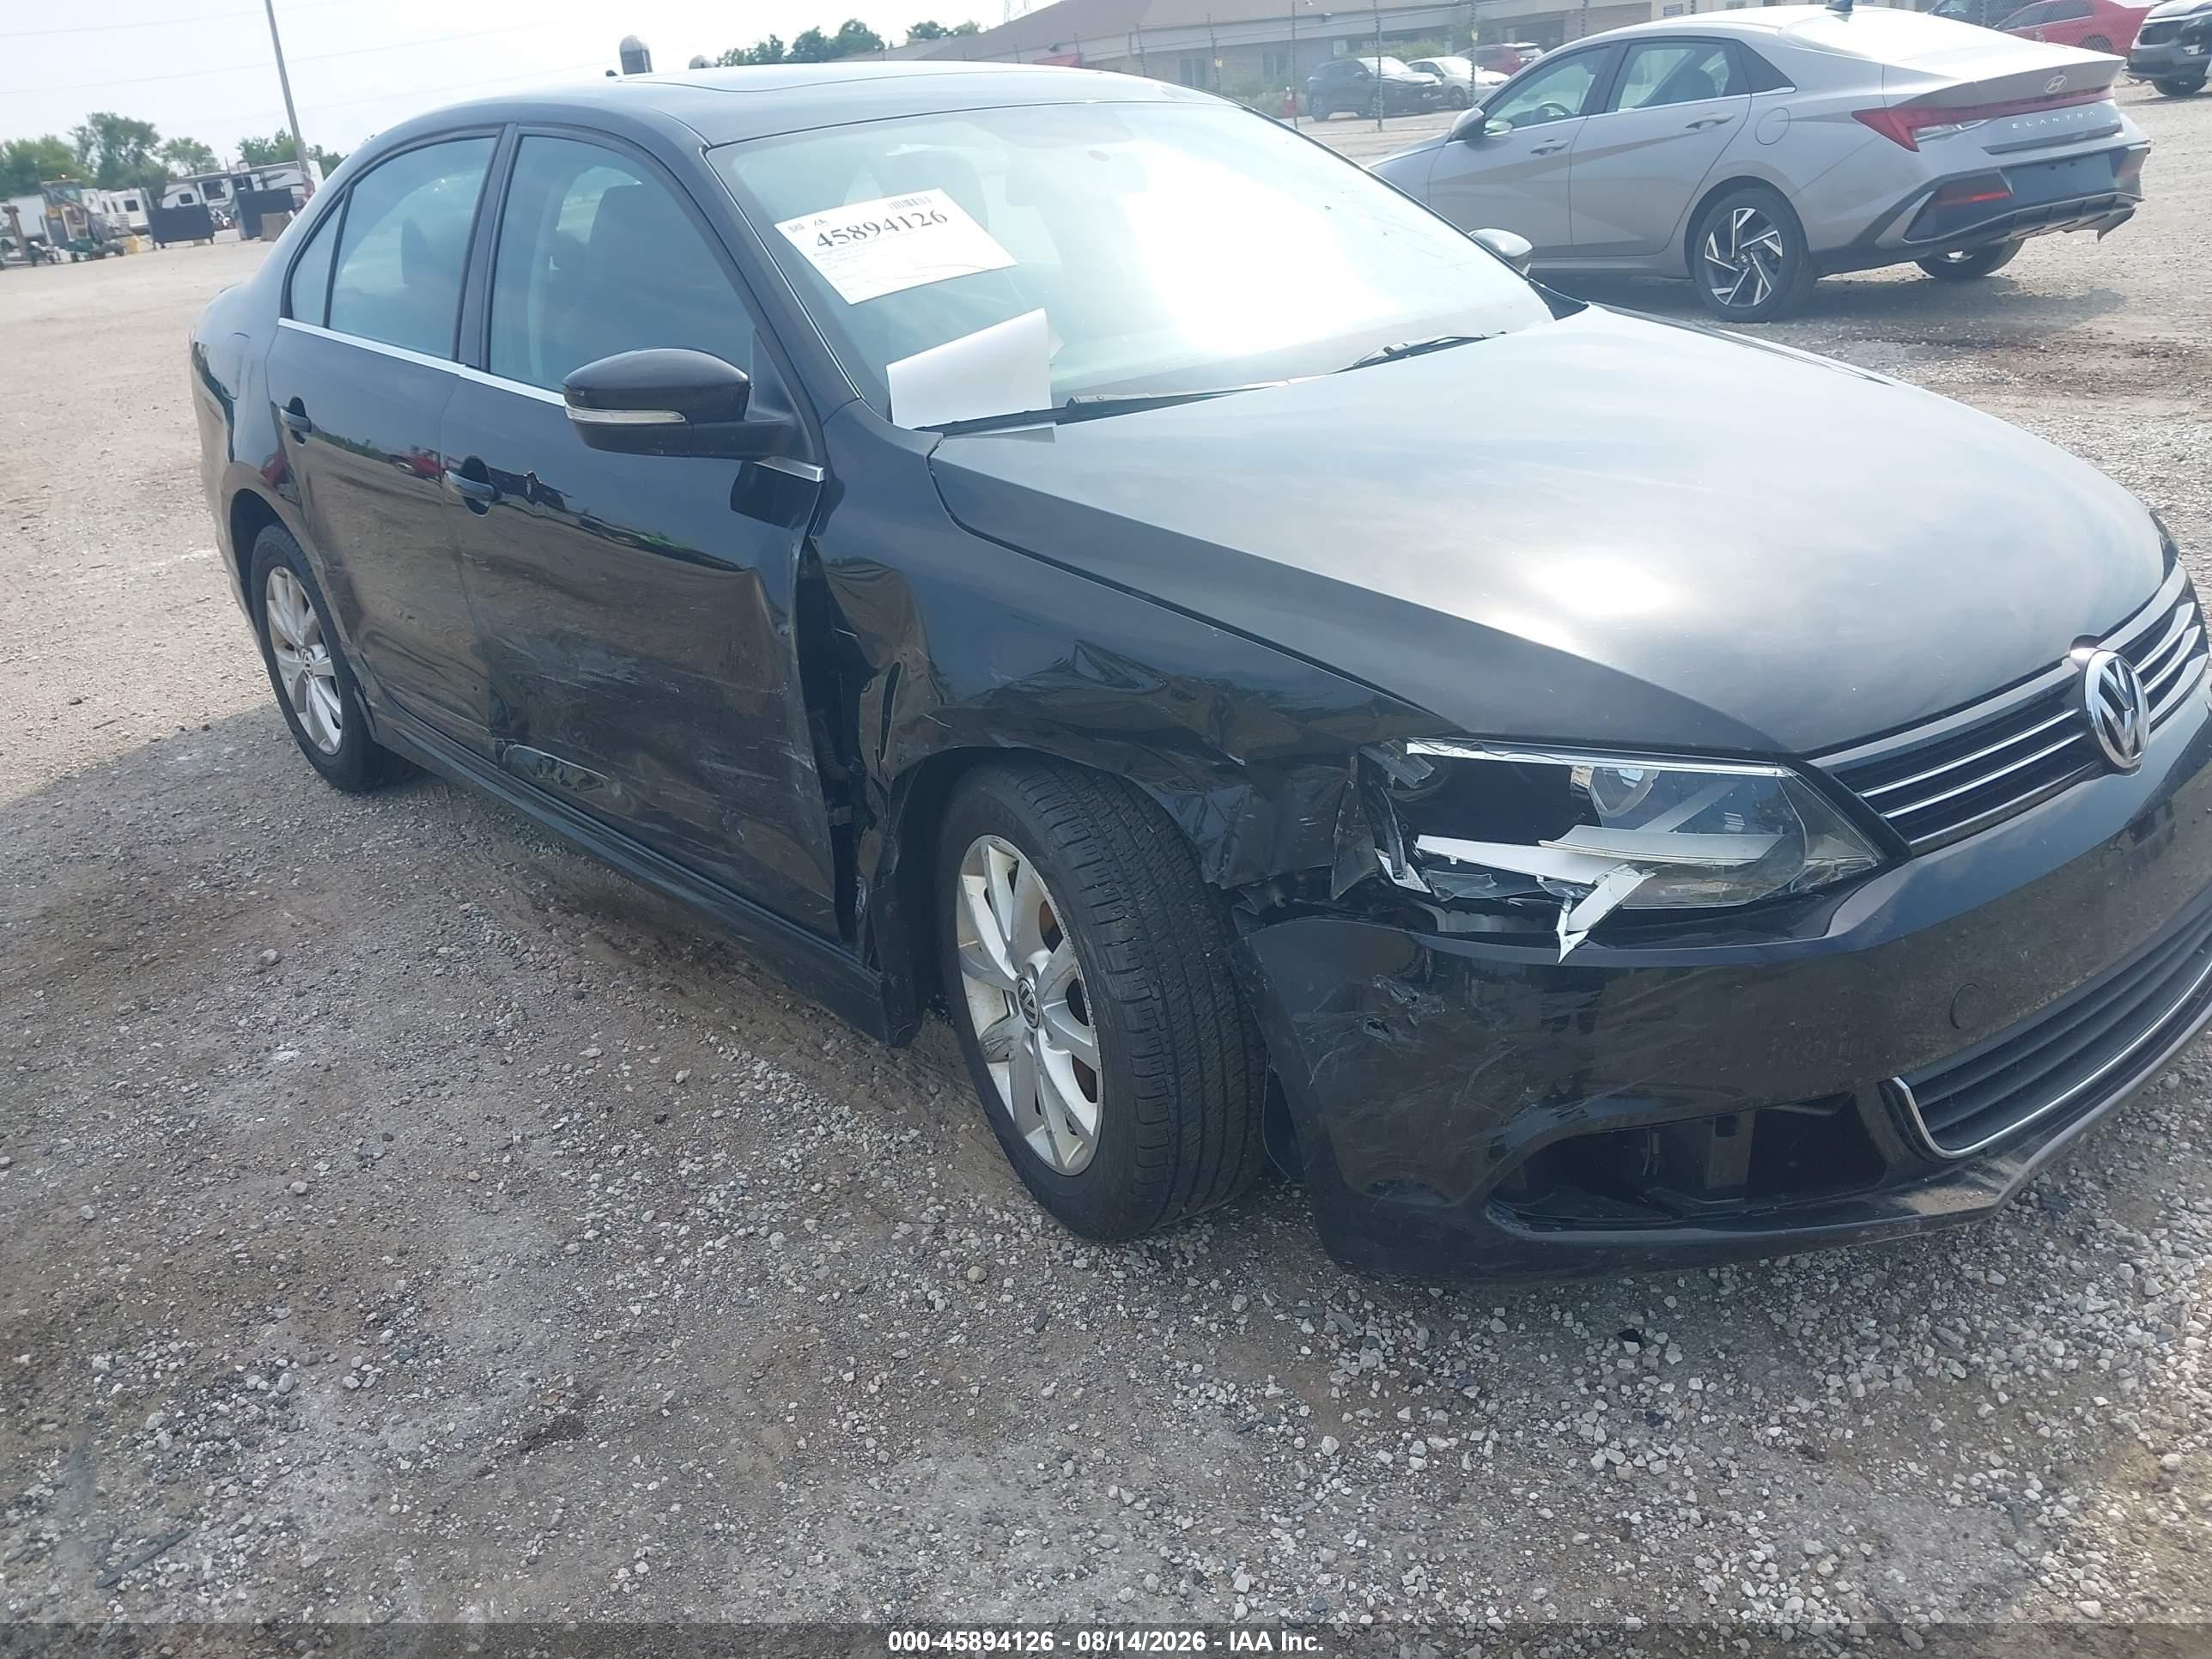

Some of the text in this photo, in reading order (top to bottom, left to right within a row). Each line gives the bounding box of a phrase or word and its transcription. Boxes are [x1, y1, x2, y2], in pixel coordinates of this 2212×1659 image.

[2012, 111, 2095, 129] ELANTRA
[817, 210, 948, 247] 45894126
[2090, 654, 2147, 764] VW
